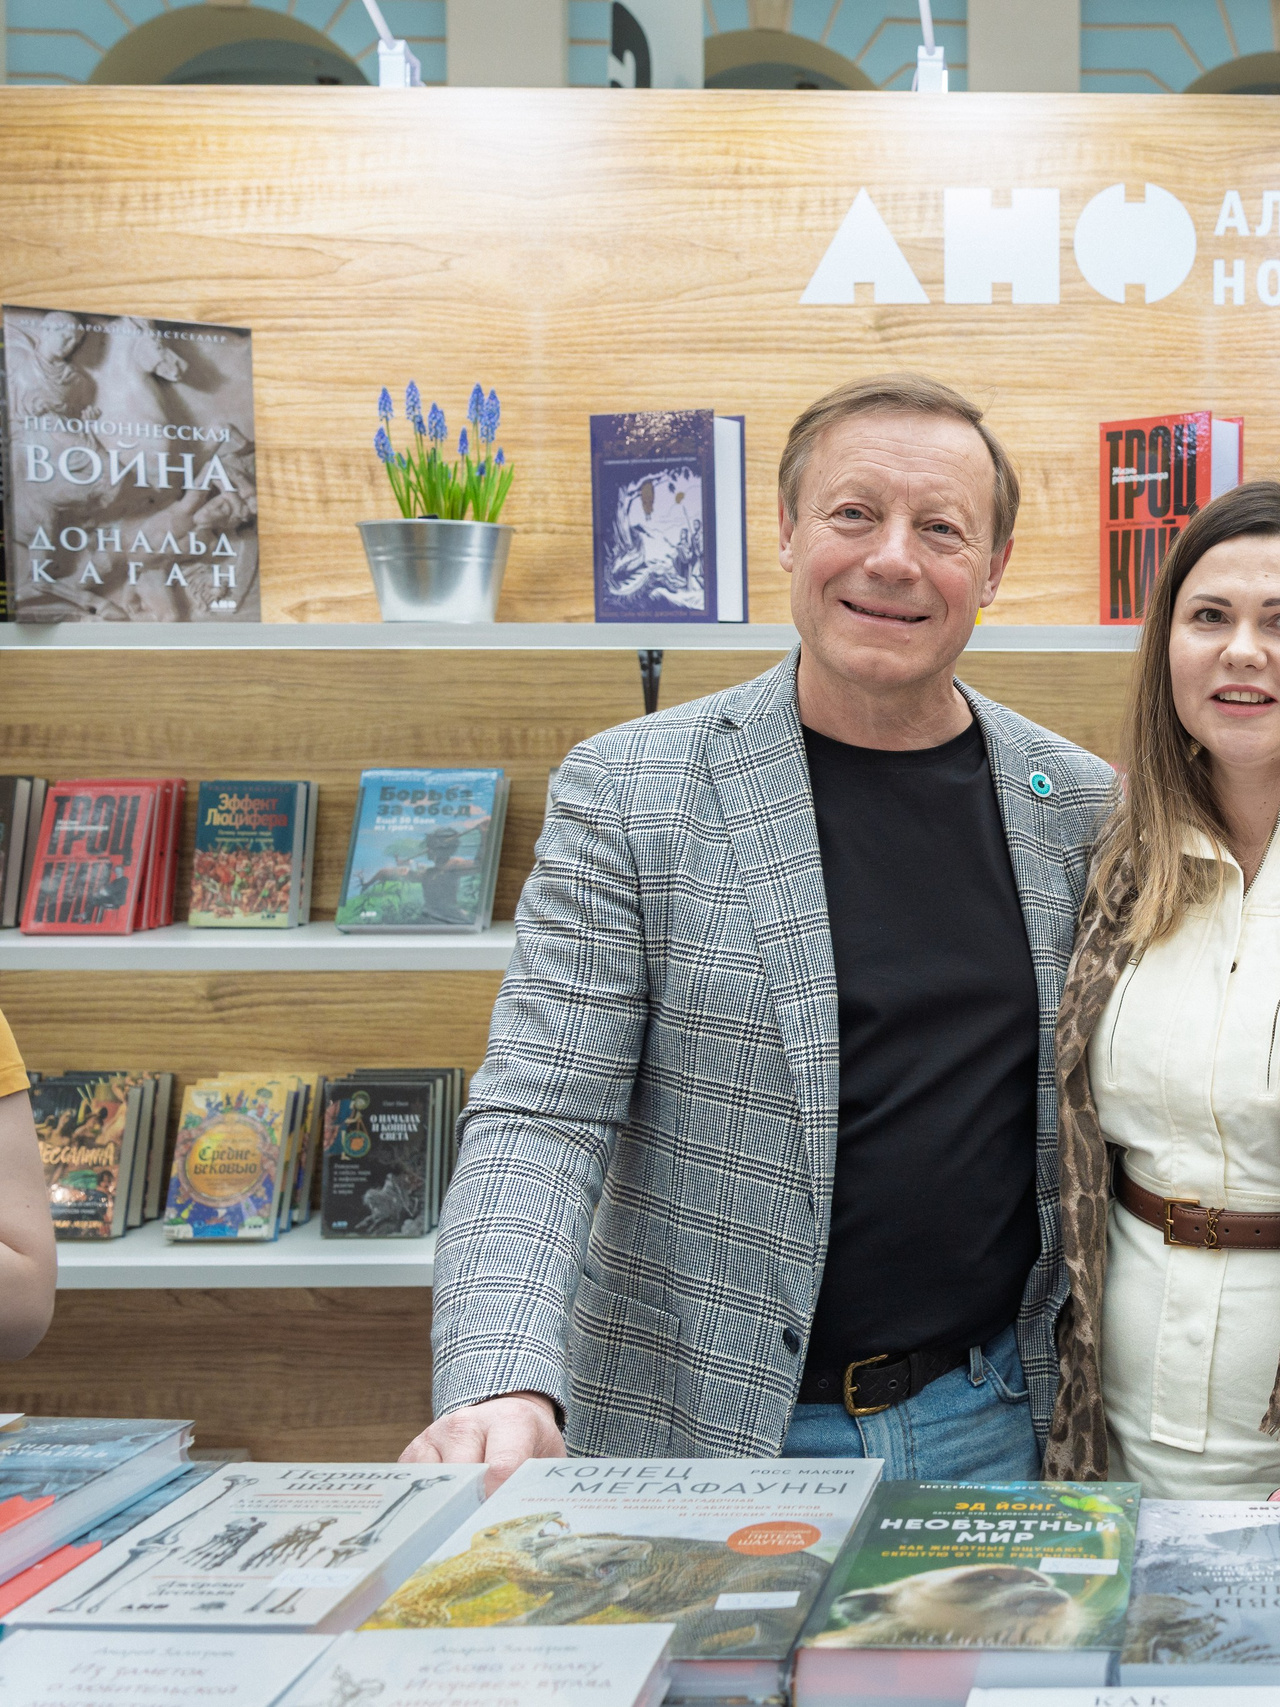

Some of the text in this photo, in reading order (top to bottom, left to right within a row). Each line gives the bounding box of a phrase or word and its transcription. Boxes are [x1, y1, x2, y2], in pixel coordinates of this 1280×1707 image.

[24, 414, 231, 443] ПЕЛОПОННЕССКАЯ
[25, 440, 238, 493] ВОЙНА
[1106, 423, 1199, 520] ТРОЦ
[28, 525, 237, 557] ДОНАЛЬД
[31, 559, 237, 588] КАГАН
[380, 785, 473, 804] Борьба
[218, 793, 279, 814] Эффект
[377, 804, 471, 817] за обед
[205, 808, 288, 830] Люцифера
[47, 795, 141, 866] ТРОЦ
[370, 1114, 420, 1123] О НАЧАЛАХ
[381, 1123, 418, 1132] КОНЦАХ
[380, 1132, 409, 1141] СВЕТА
[198, 1146, 256, 1163] Средне-
[193, 1163, 257, 1174] вековью
[277, 1470, 412, 1483] Первые
[544, 1466, 693, 1480] КОНЕЦ
[285, 1481, 376, 1491] шаги
[568, 1482, 848, 1494] МЕГАФАУНЫ
[954, 1501, 1056, 1511] ЭД ЙОНГ
[880, 1516, 1116, 1532] НЕОБЪЯТНЫЙ
[747, 1532, 803, 1540] ПИТЕРА
[956, 1532, 1034, 1543] МИР
